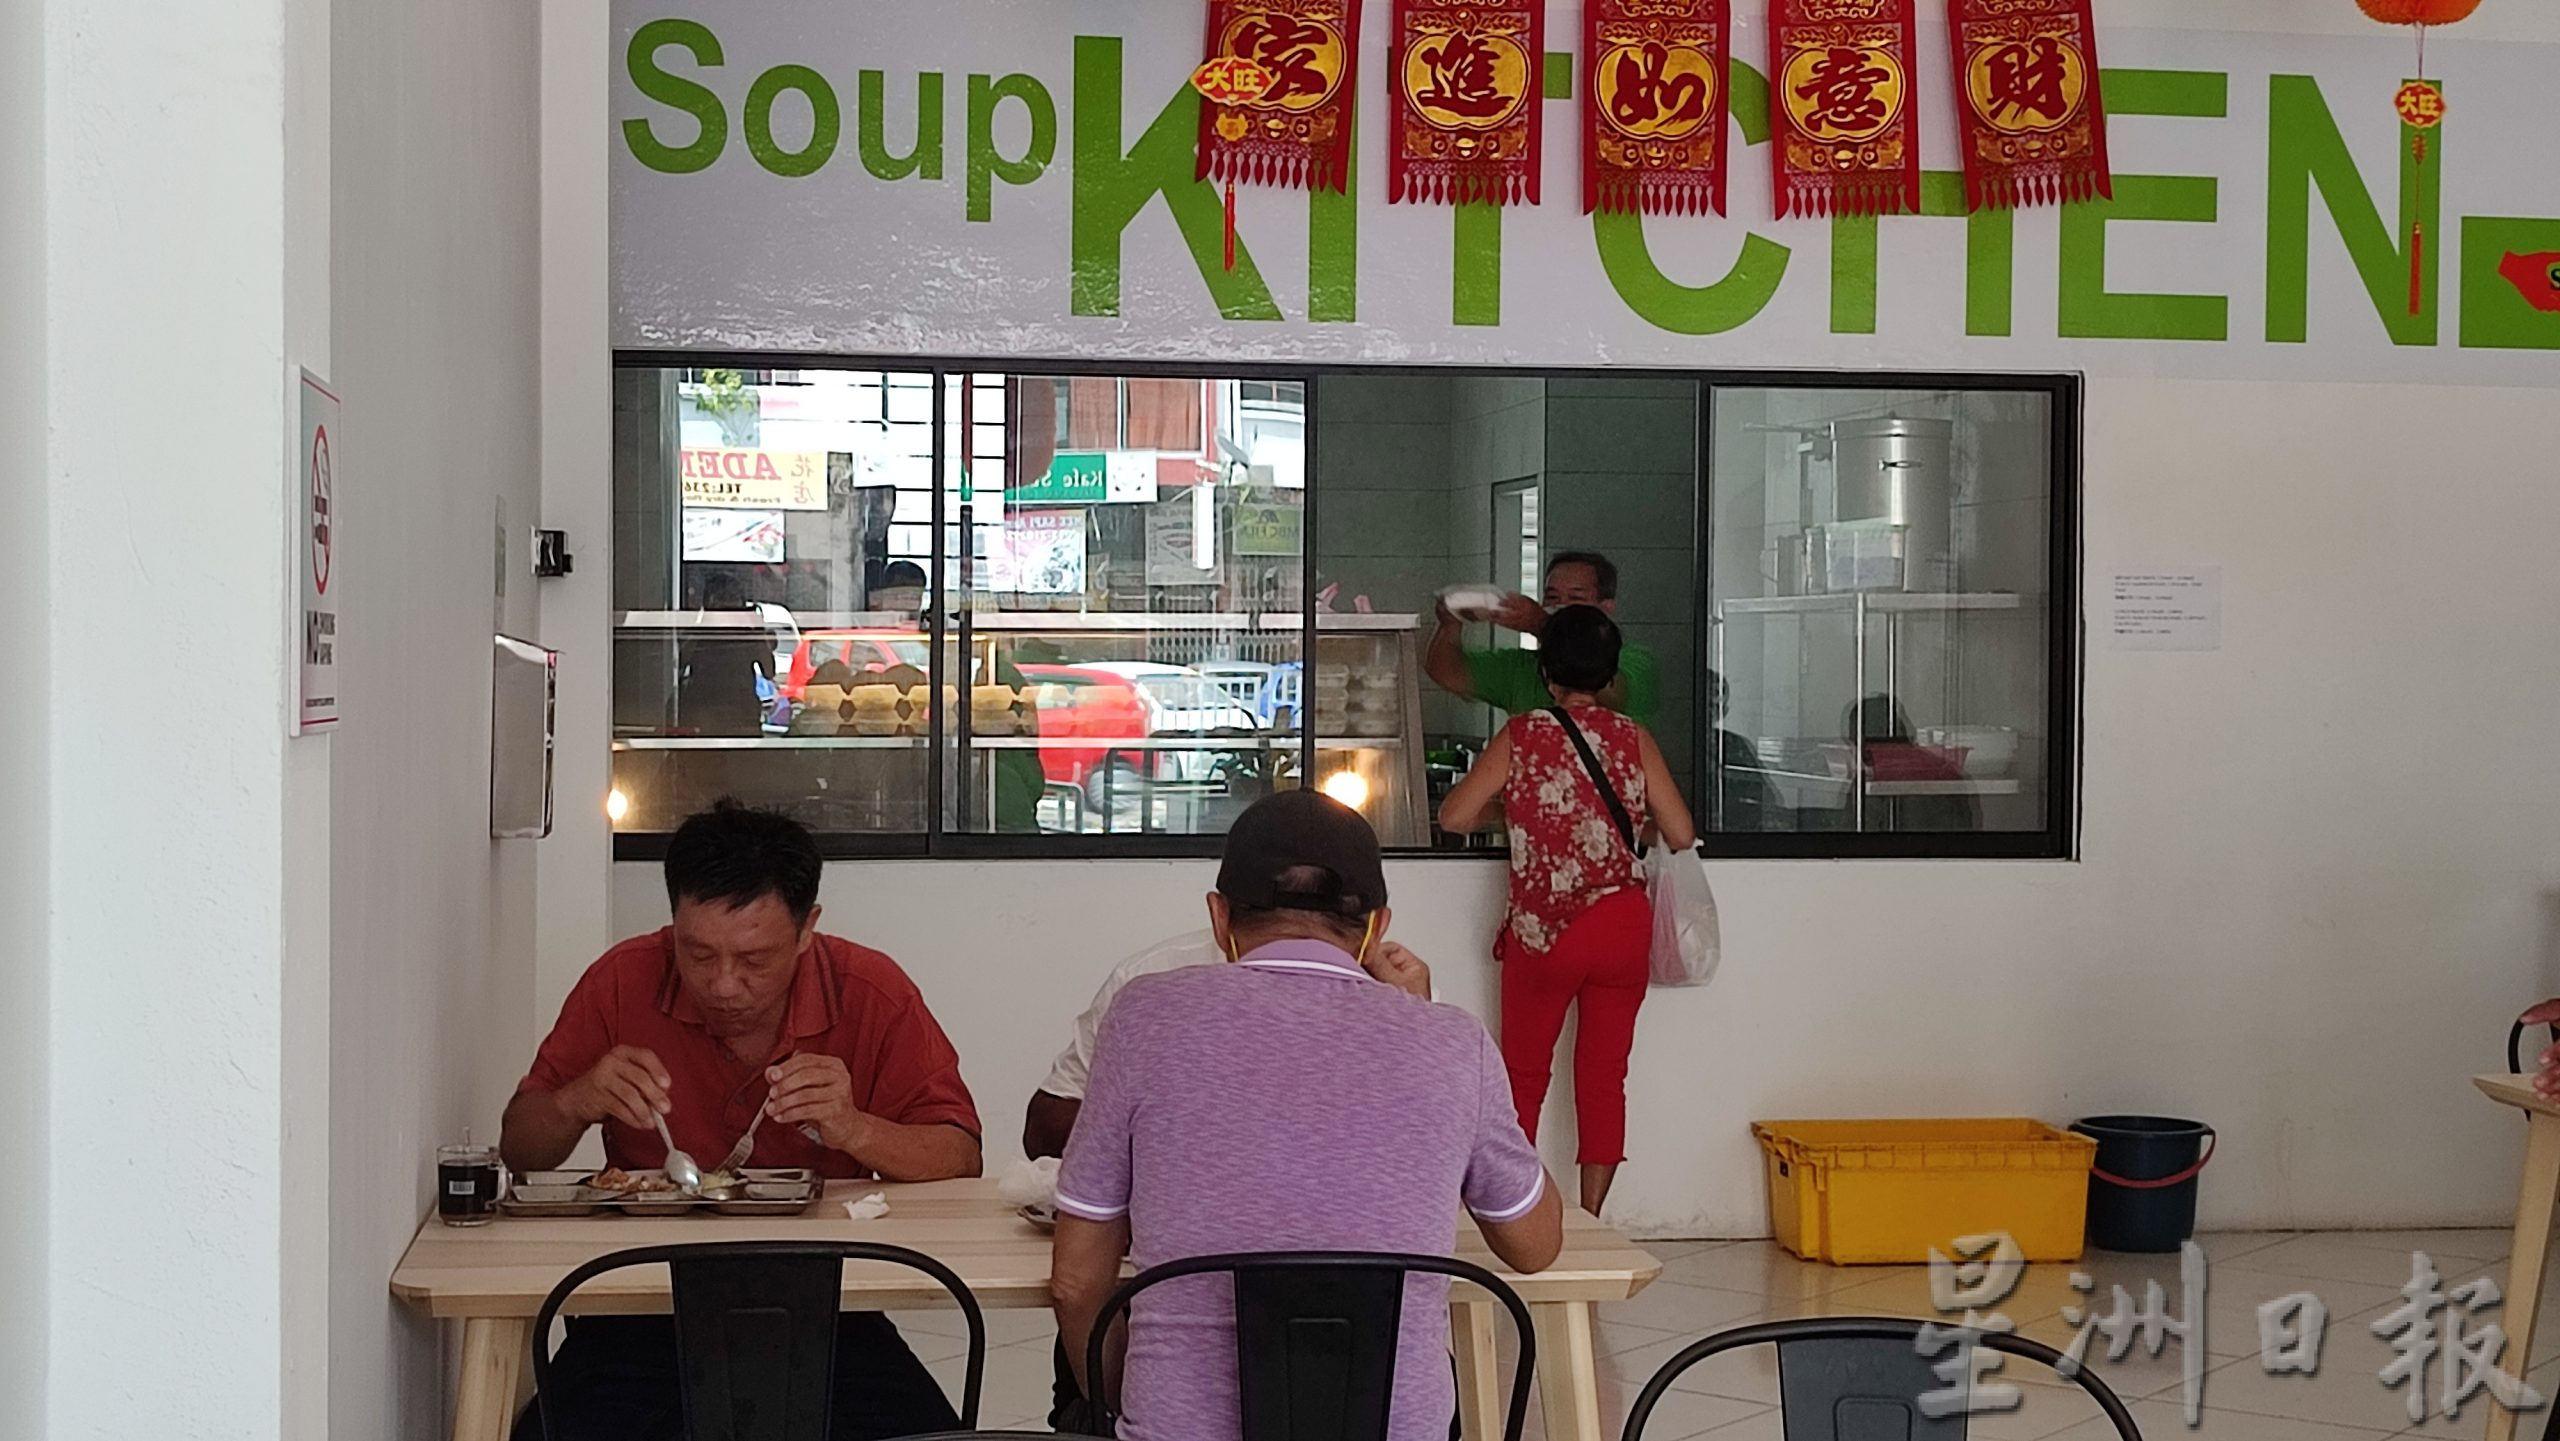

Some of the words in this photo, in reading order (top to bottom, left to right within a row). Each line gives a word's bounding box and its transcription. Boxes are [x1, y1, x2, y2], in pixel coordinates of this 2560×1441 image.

[621, 17, 1057, 223] Soup
[1201, 66, 1264, 92] 大旺
[1611, 39, 1707, 128] 如
[1794, 47, 1892, 132] 意
[2398, 91, 2441, 117] 大旺
